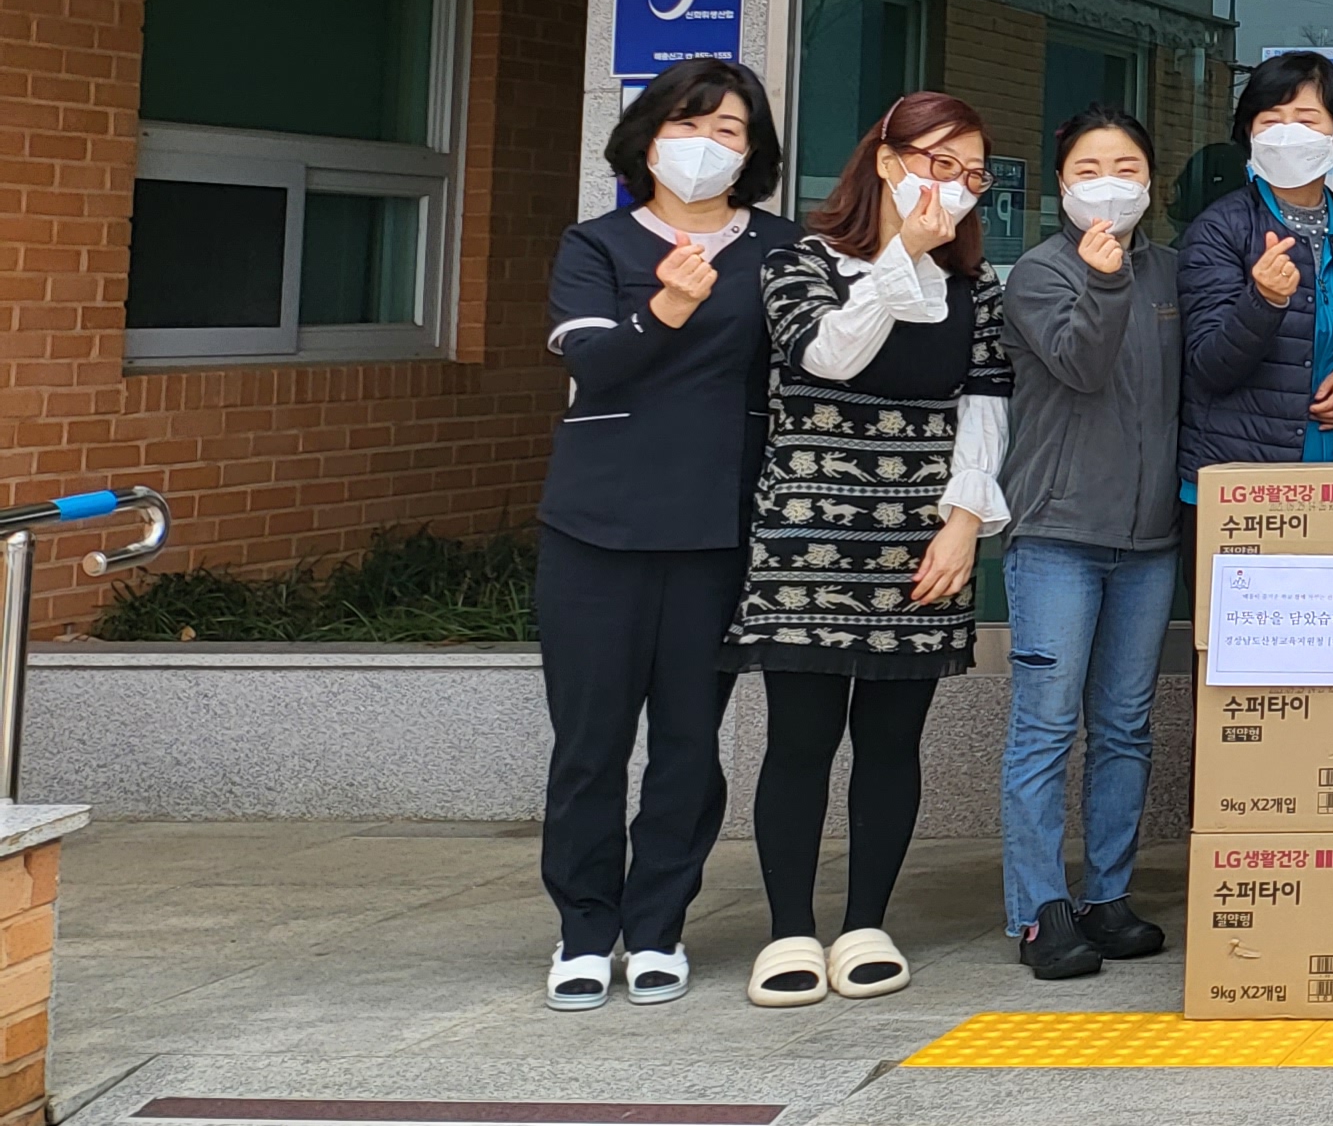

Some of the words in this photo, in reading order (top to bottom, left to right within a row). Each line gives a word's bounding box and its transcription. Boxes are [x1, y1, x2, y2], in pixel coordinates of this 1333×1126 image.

[1220, 514, 1308, 539] 수퍼타이
[1227, 610, 1283, 626] 따뜻함을
[1223, 695, 1310, 720] 수퍼타이
[1220, 798, 1246, 814] 9kg
[1250, 797, 1297, 813] X2개입
[1213, 880, 1301, 906] 수퍼타이
[1215, 913, 1251, 927] 절약형
[1210, 986, 1236, 1003] 9kg
[1240, 985, 1287, 1002] X2개입
